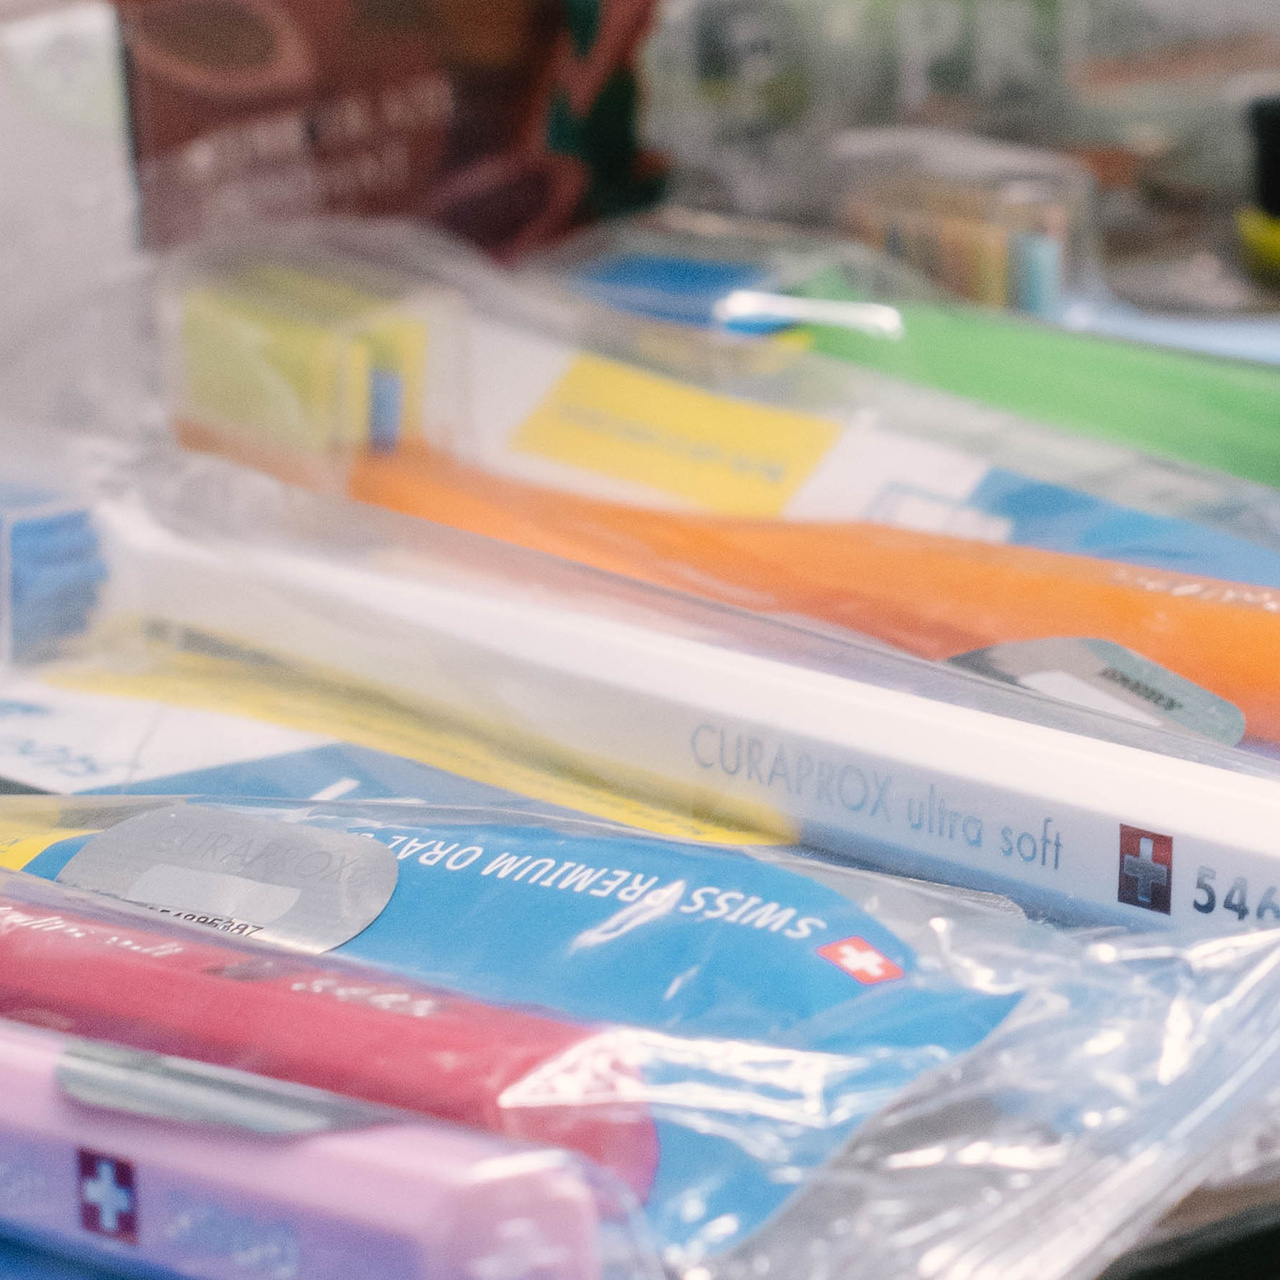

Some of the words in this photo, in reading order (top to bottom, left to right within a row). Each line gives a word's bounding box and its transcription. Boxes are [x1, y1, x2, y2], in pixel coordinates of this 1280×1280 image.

[690, 723, 893, 823] CURAPROX
[907, 783, 984, 848] ultra
[1000, 817, 1062, 871] soft
[386, 835, 484, 871] ORAL
[680, 886, 828, 940] SWISS
